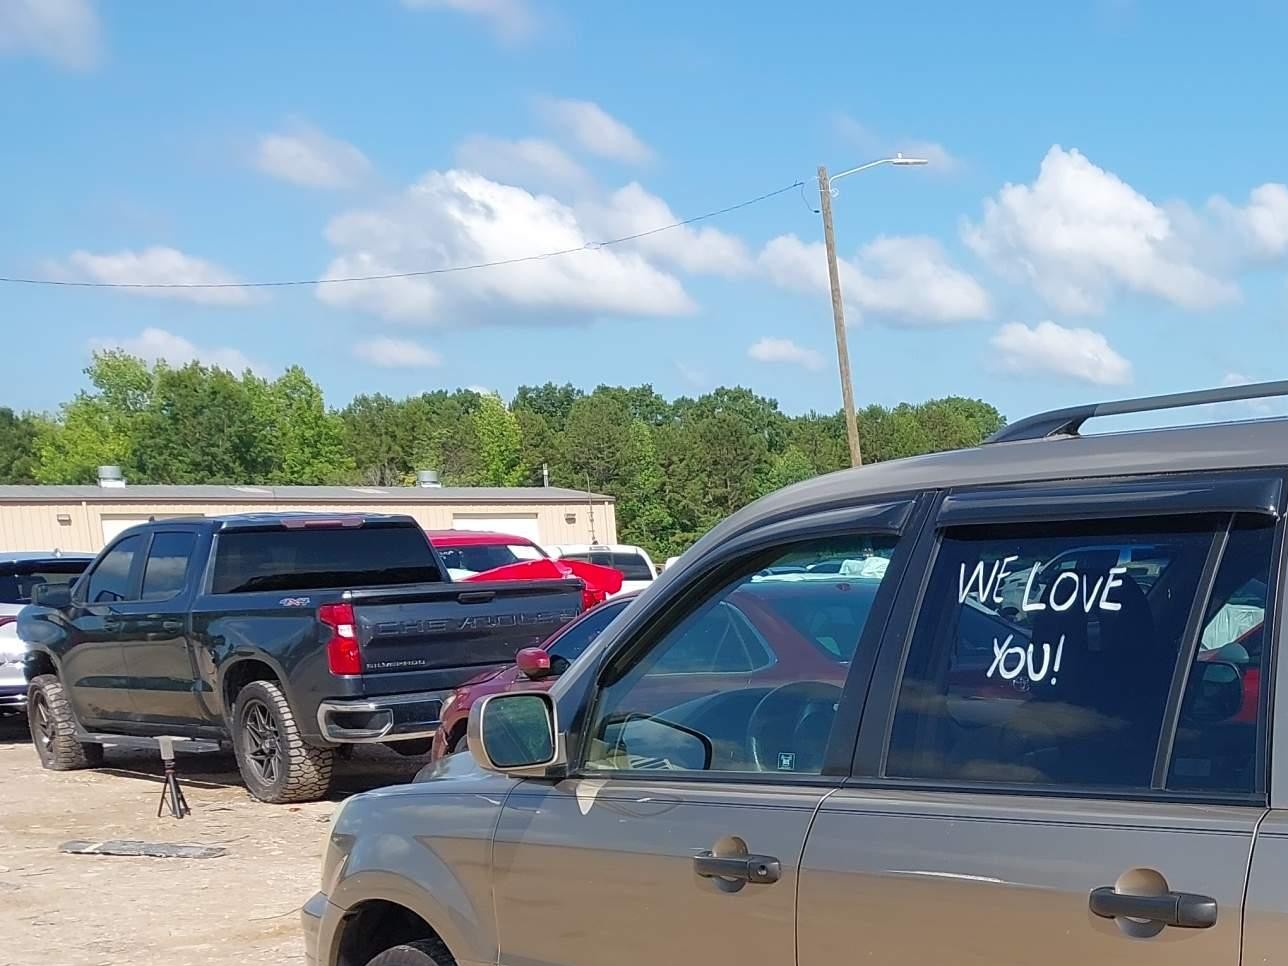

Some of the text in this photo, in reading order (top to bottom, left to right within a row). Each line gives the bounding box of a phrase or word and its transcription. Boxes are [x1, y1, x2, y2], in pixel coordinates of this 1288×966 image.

[958, 555, 1127, 613] WE LOVE
[986, 633, 1066, 686] YOU!
